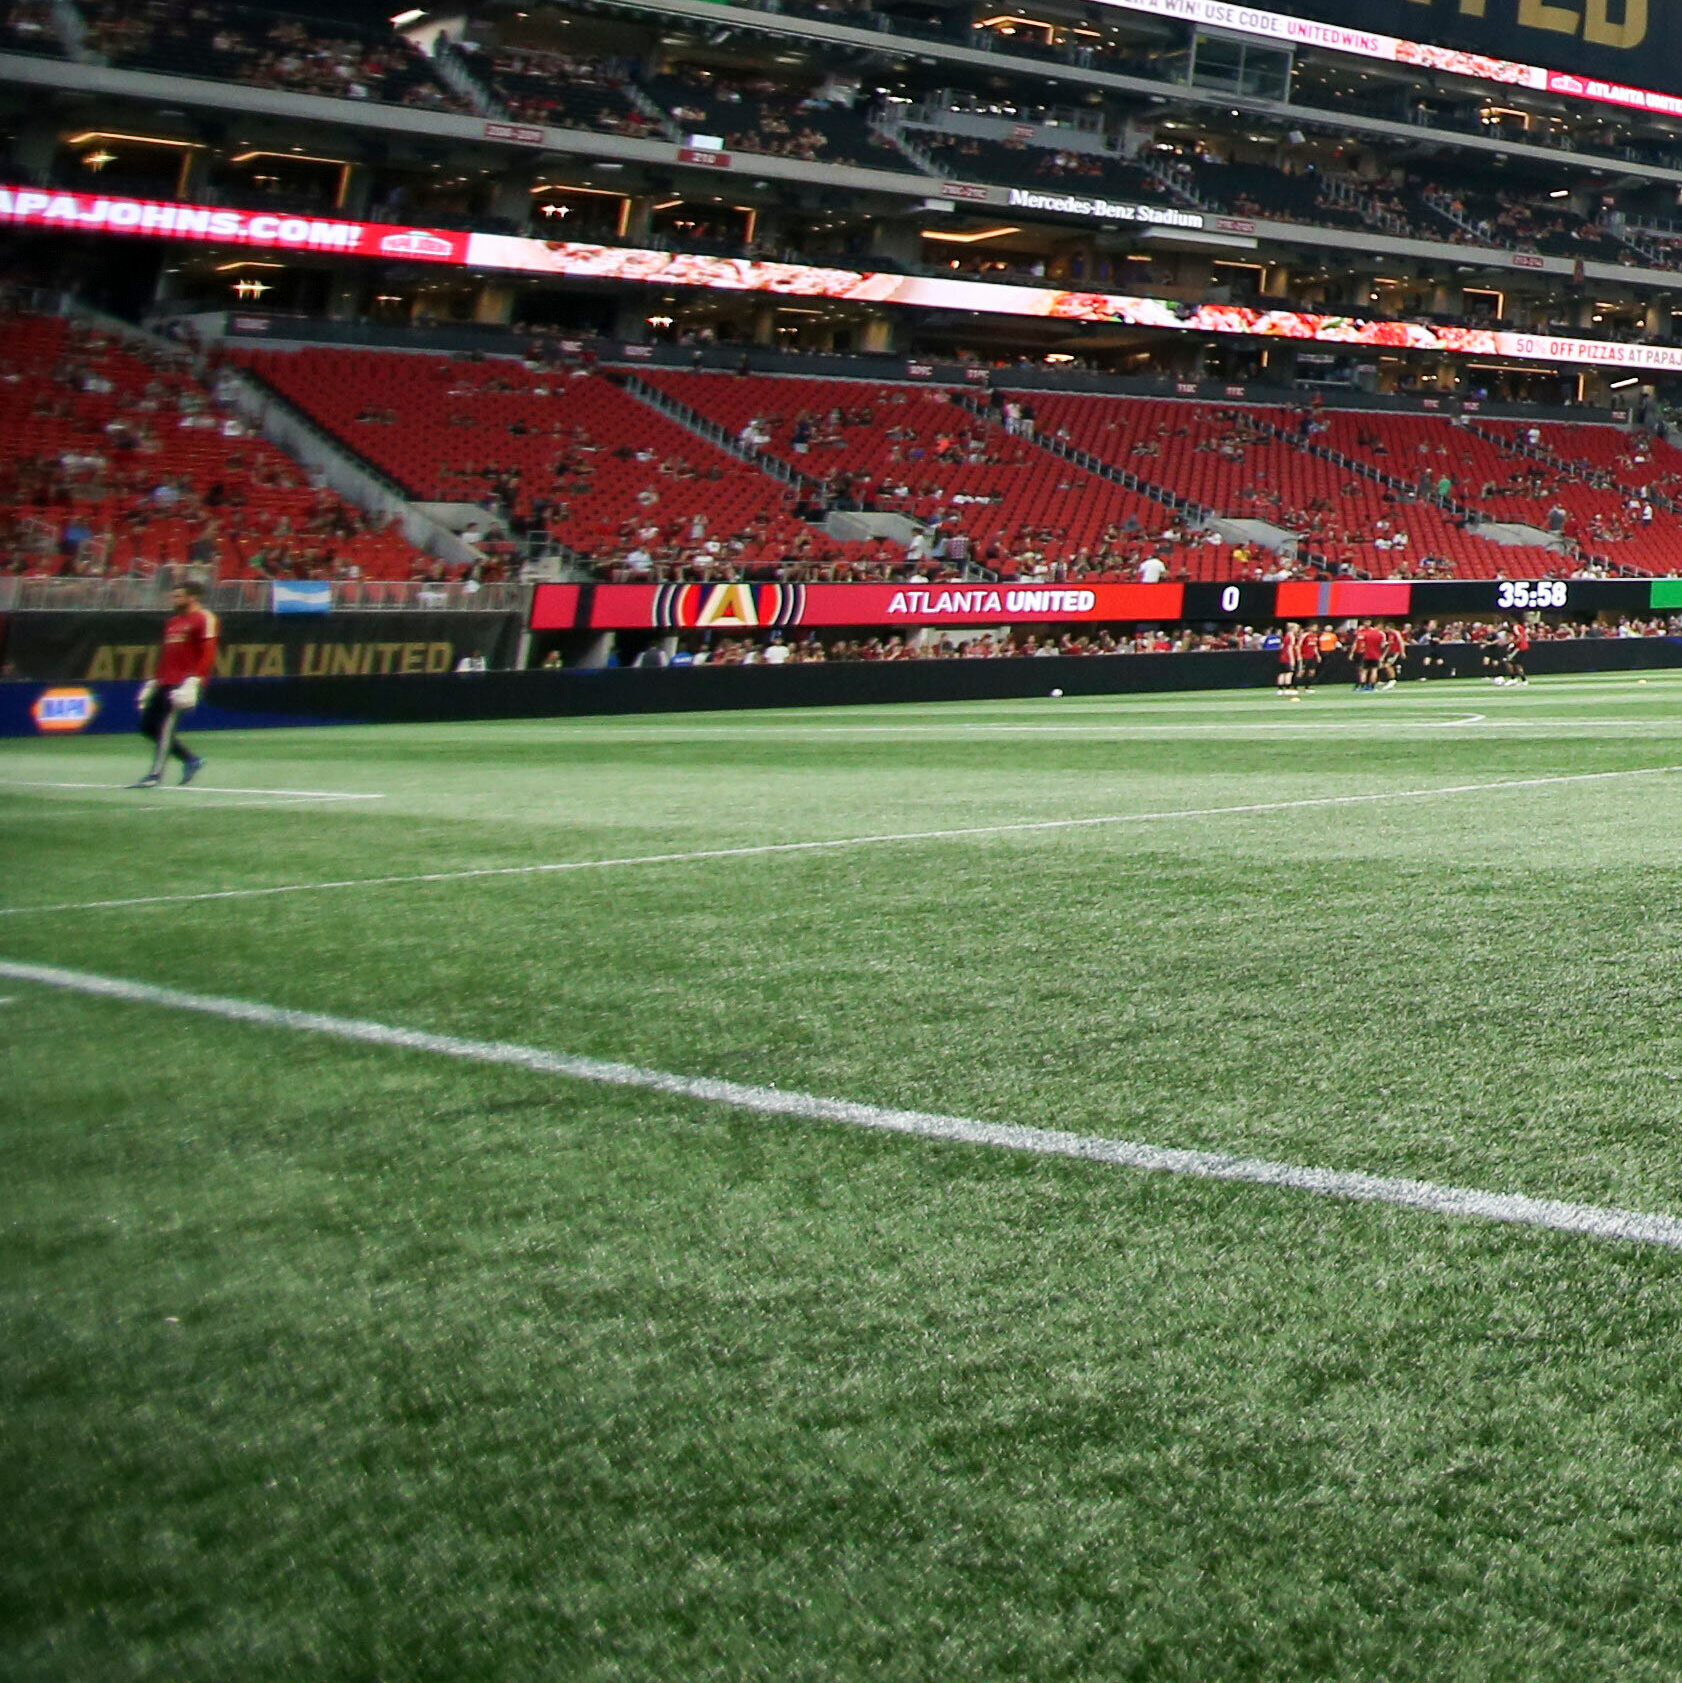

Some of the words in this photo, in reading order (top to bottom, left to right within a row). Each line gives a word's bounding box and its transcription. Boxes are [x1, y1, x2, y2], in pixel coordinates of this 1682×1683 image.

[1205, 4, 1233, 22] USE
[1287, 21, 1379, 51] UNITEDWINS
[1586, 81, 1646, 106] ATLANTA
[1009, 189, 1135, 219] Mercedes-Benz
[1136, 206, 1203, 229] Stadium
[1550, 342, 1574, 357] OFF
[1578, 344, 1624, 361] PIZZAS
[1628, 349, 1643, 361] AT
[888, 591, 1001, 613] ATLANTA
[1006, 590, 1095, 611] UNITED
[1221, 586, 1240, 611] 0
[1497, 581, 1567, 609] 35:58
[301, 641, 453, 676] UNITED
